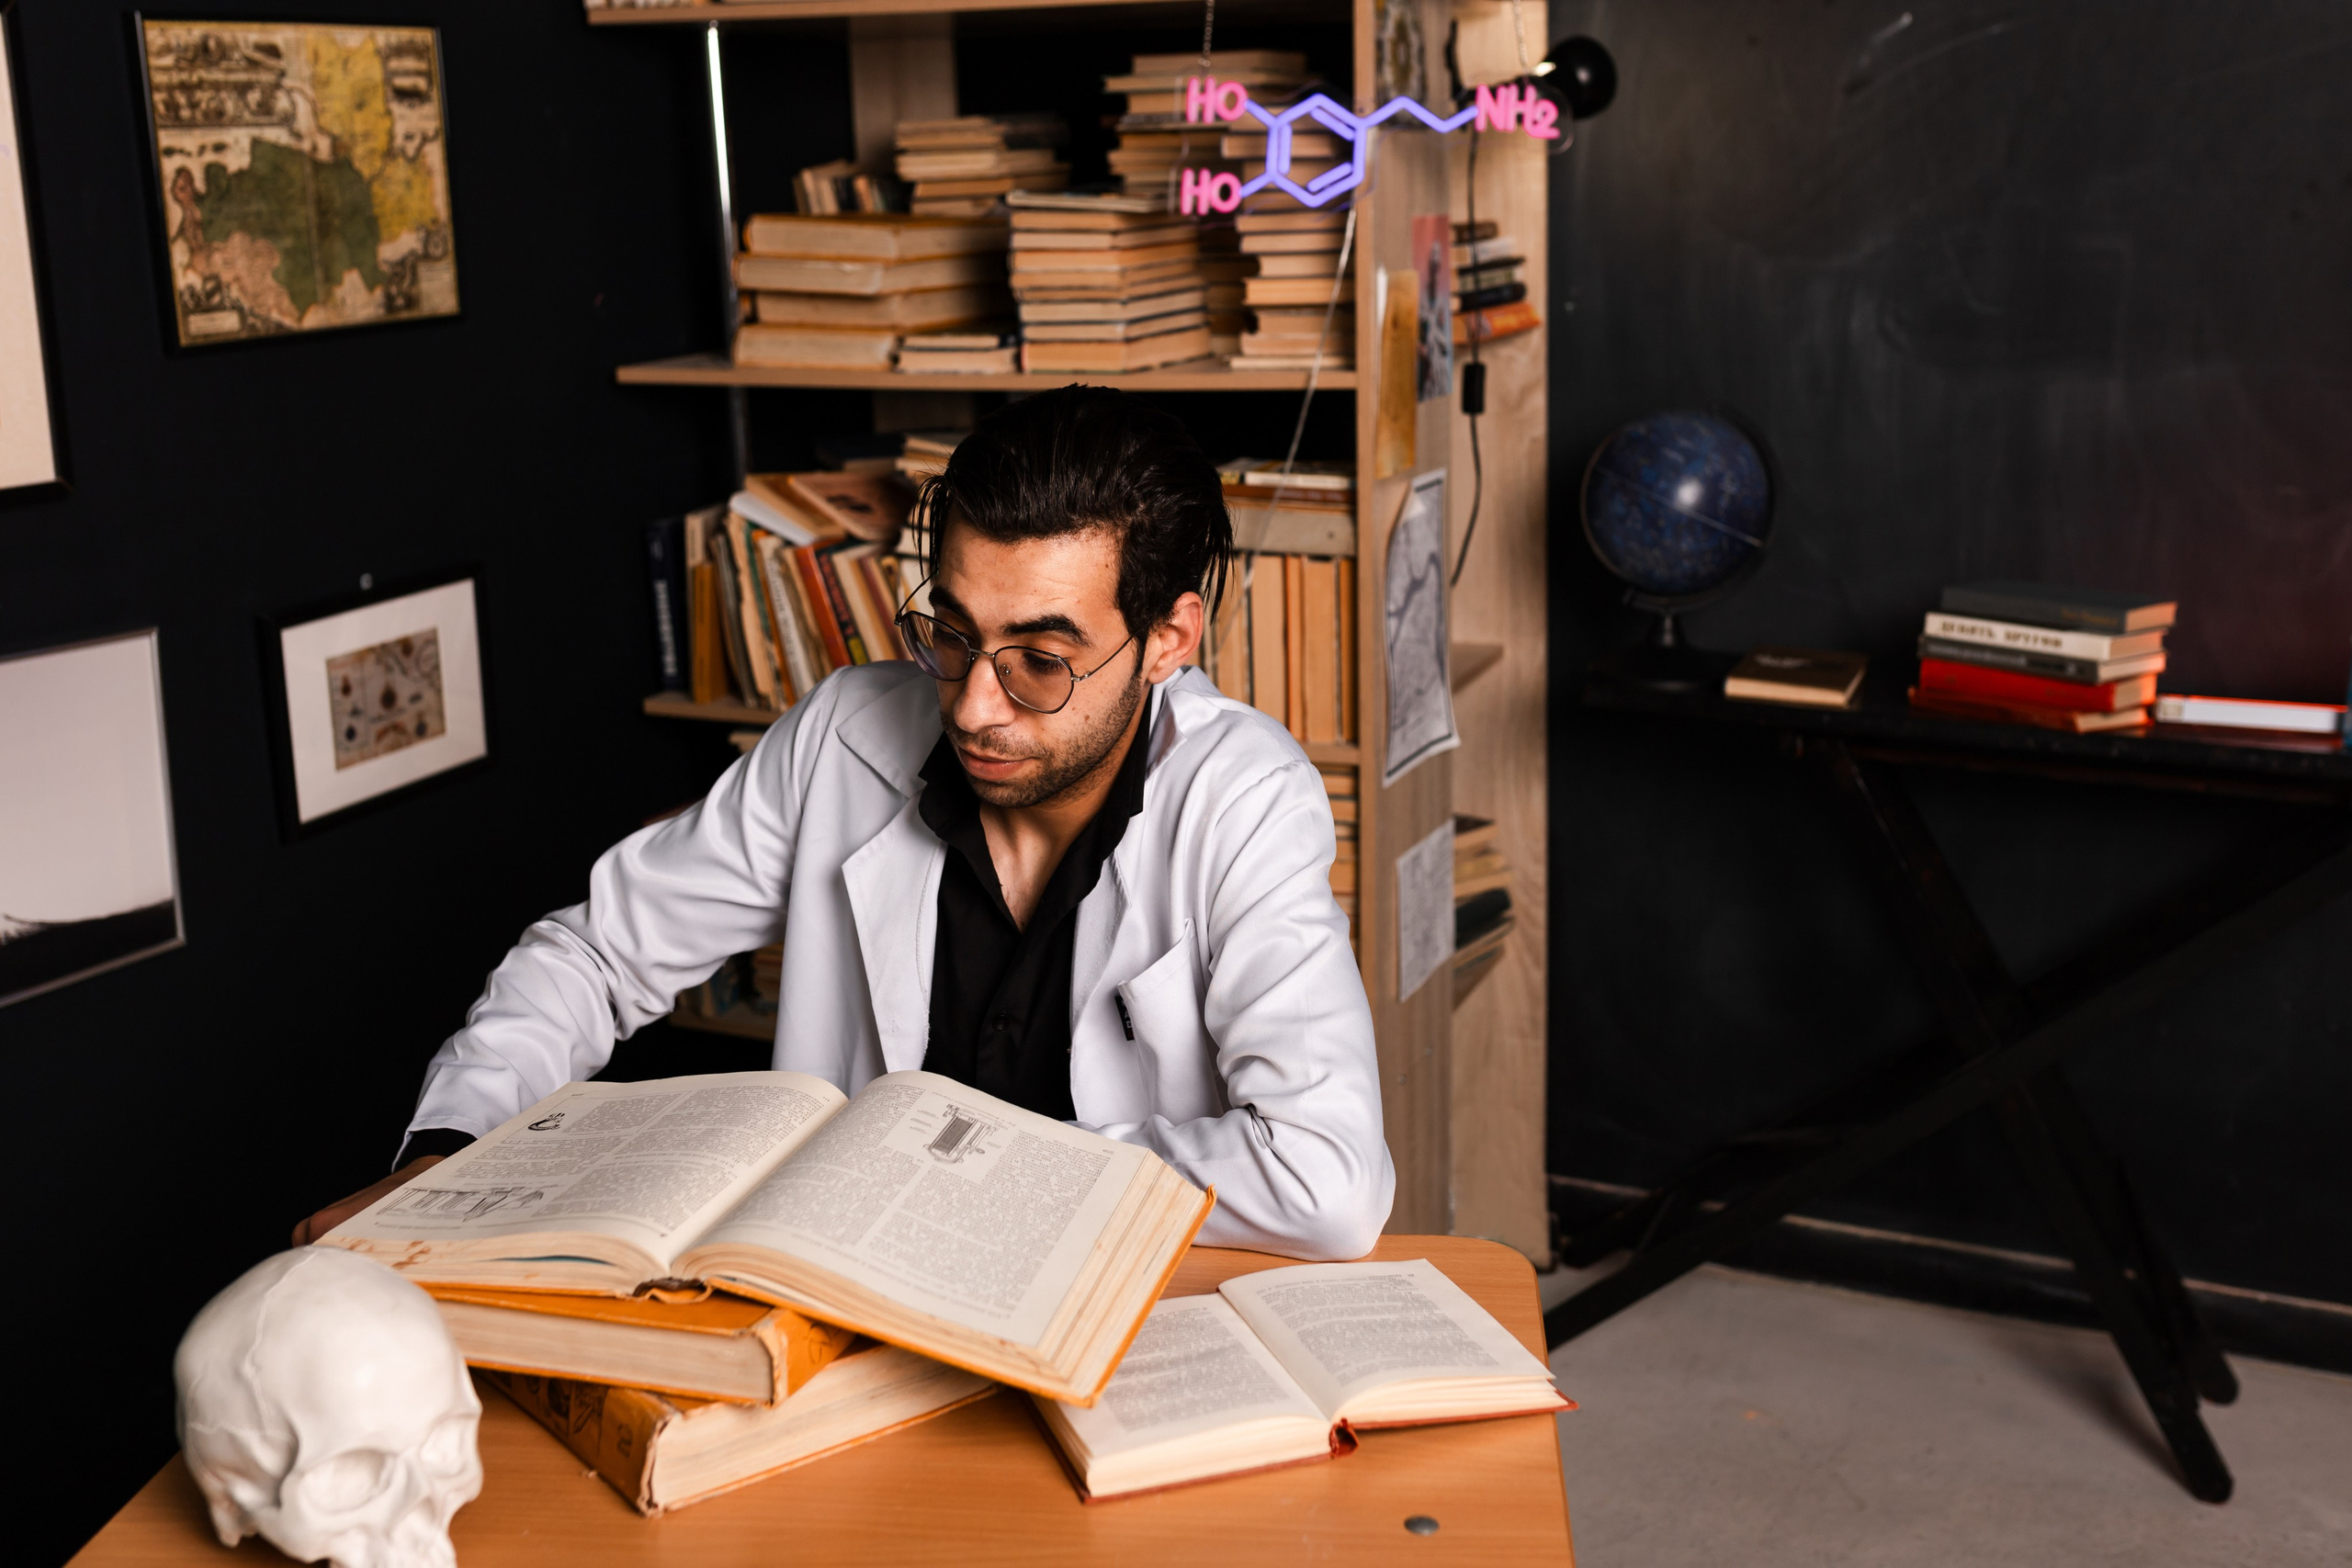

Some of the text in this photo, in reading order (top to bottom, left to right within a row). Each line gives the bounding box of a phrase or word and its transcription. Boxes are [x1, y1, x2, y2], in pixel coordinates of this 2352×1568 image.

[1186, 76, 1248, 124] HO
[1475, 84, 1560, 139] NH2
[1181, 168, 1242, 216] HO
